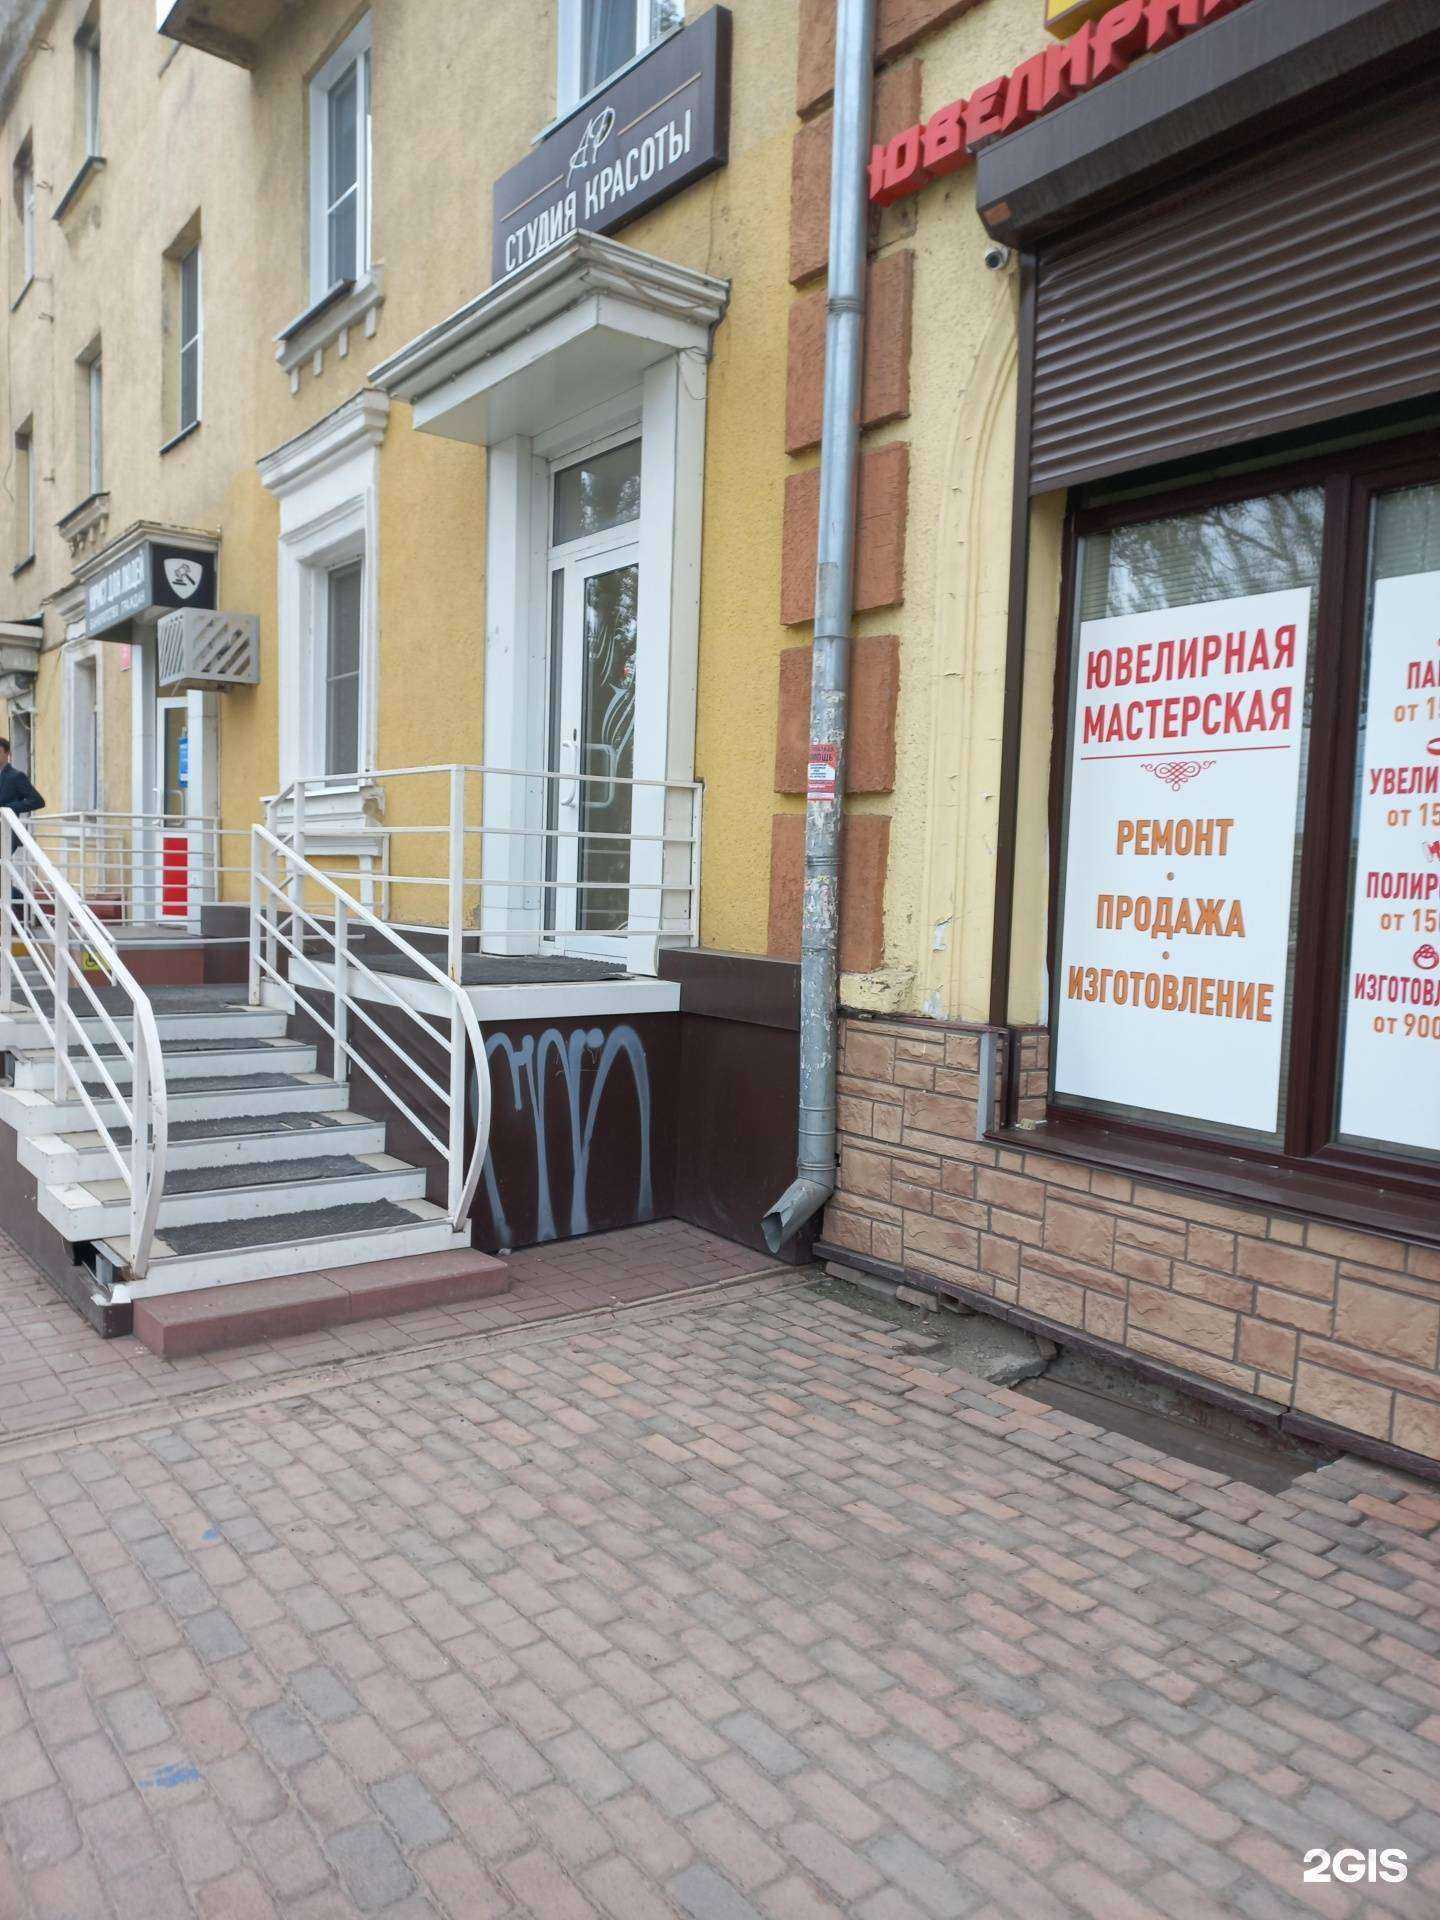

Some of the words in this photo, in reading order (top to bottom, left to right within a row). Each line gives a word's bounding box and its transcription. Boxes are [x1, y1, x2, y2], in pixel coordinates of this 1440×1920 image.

[867, 0, 1222, 201] ЮВЕЛИРН
[505, 190, 577, 272] СТУДИЯ
[584, 109, 692, 220] КРАСОТЫ
[1085, 624, 1297, 690] ЮВЕЛИРНАЯ
[1406, 660, 1440, 690] ПА
[1083, 686, 1293, 744] МАСТЕРСКАЯ
[1394, 703, 1418, 722] от
[1370, 766, 1439, 795] УВЕЛИ
[1388, 809, 1411, 826] от
[1116, 818, 1234, 856] РЕМОНТ
[1366, 871, 1440, 900] ПОЛИР
[1097, 894, 1246, 940] ПРОДАЖА
[1380, 912, 1404, 931] от
[1413, 908, 1440, 933] 15
[1068, 965, 1274, 1023] ИЗГОТОВЛЕНИЕ
[1374, 1015, 1397, 1035] от
